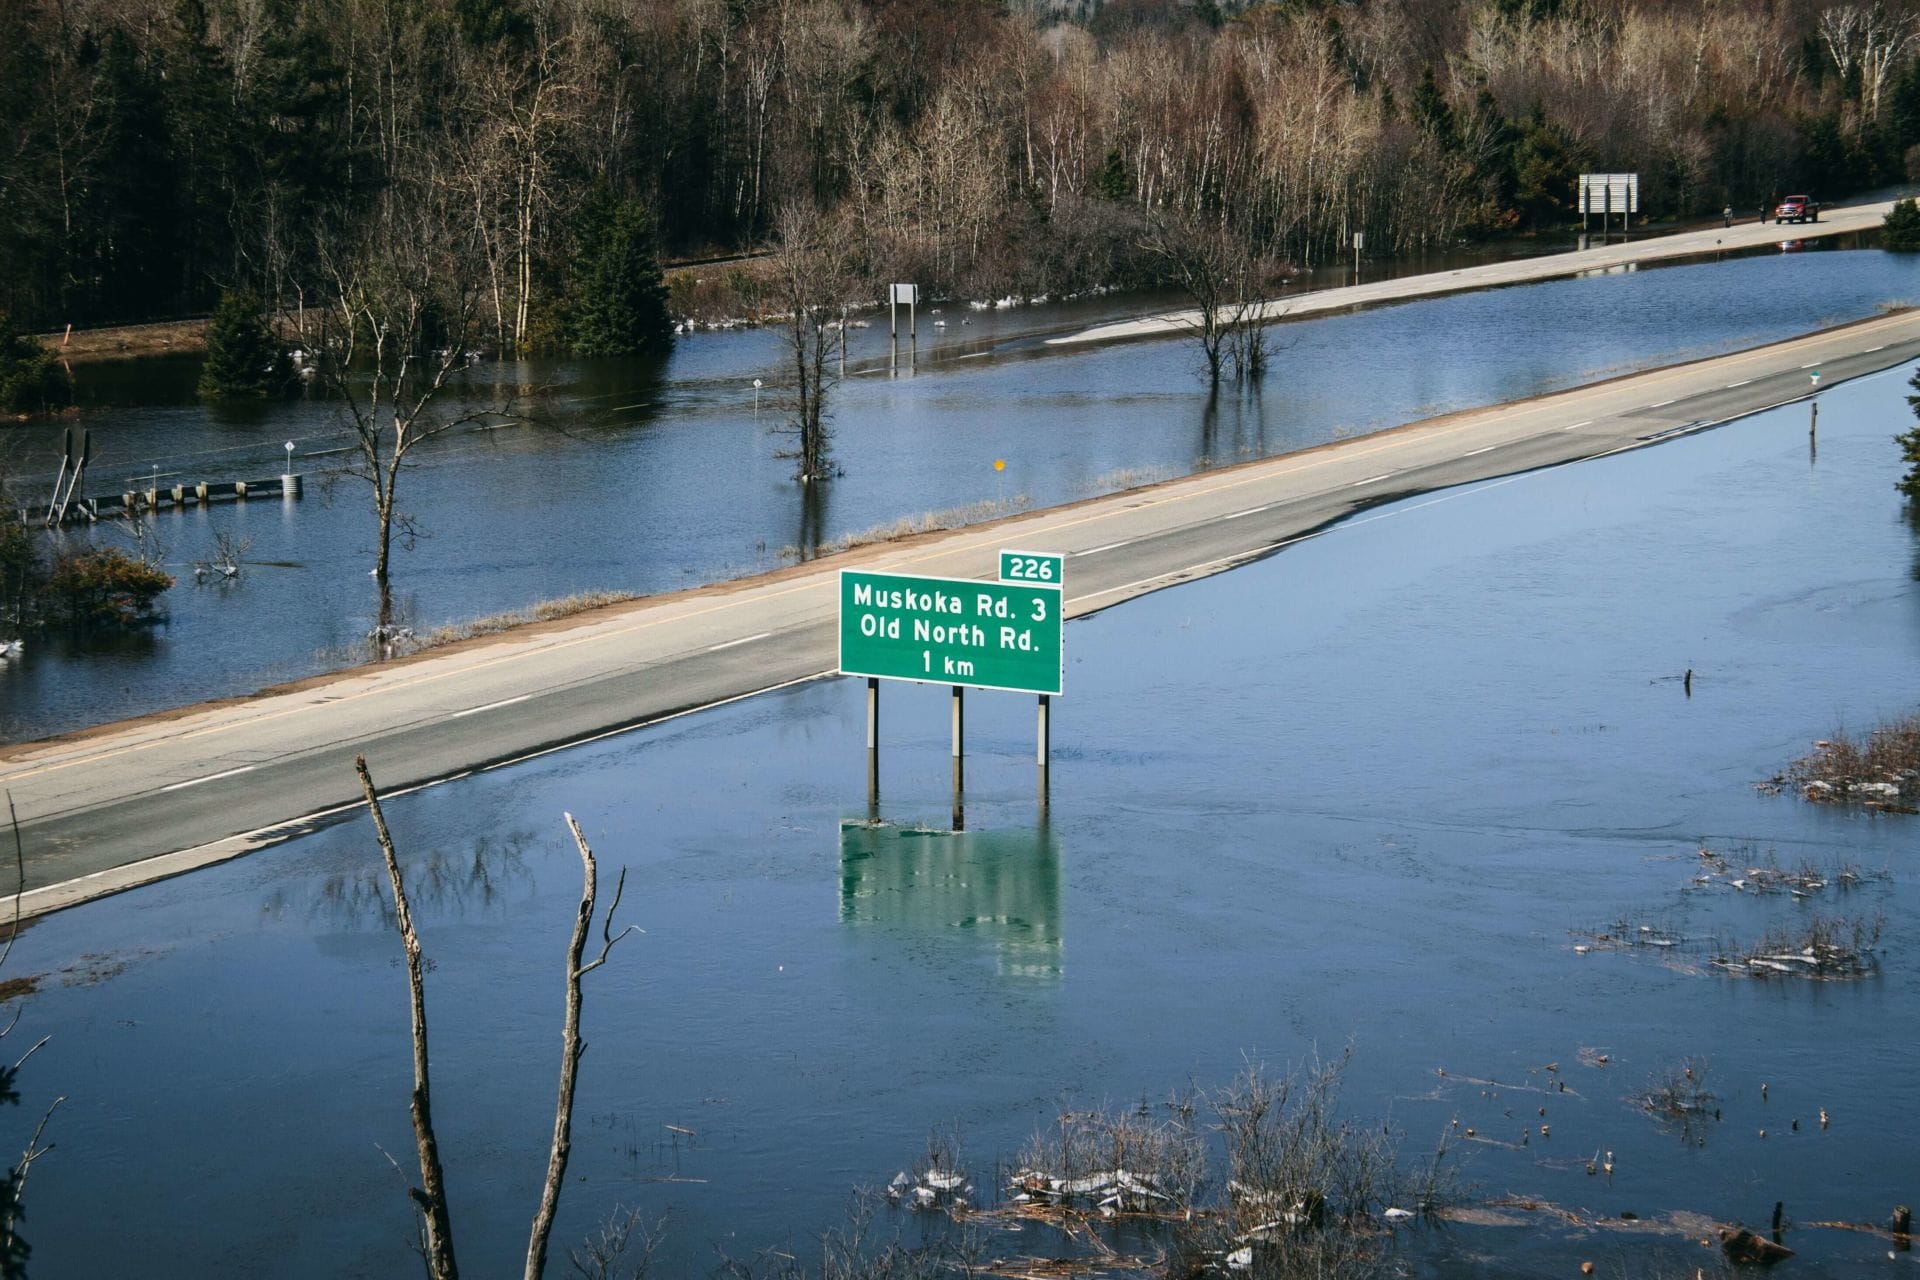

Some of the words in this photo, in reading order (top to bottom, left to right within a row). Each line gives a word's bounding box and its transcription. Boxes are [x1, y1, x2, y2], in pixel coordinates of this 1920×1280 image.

[1010, 557, 1053, 580] 226
[854, 583, 963, 614] Muskoka
[977, 594, 1016, 619] Rd.
[1031, 598, 1046, 622] 3
[860, 613, 900, 640] Old
[914, 619, 985, 647] North
[1000, 626, 1039, 652] Rd.
[923, 650, 932, 672] 1
[944, 656, 974, 677] km
